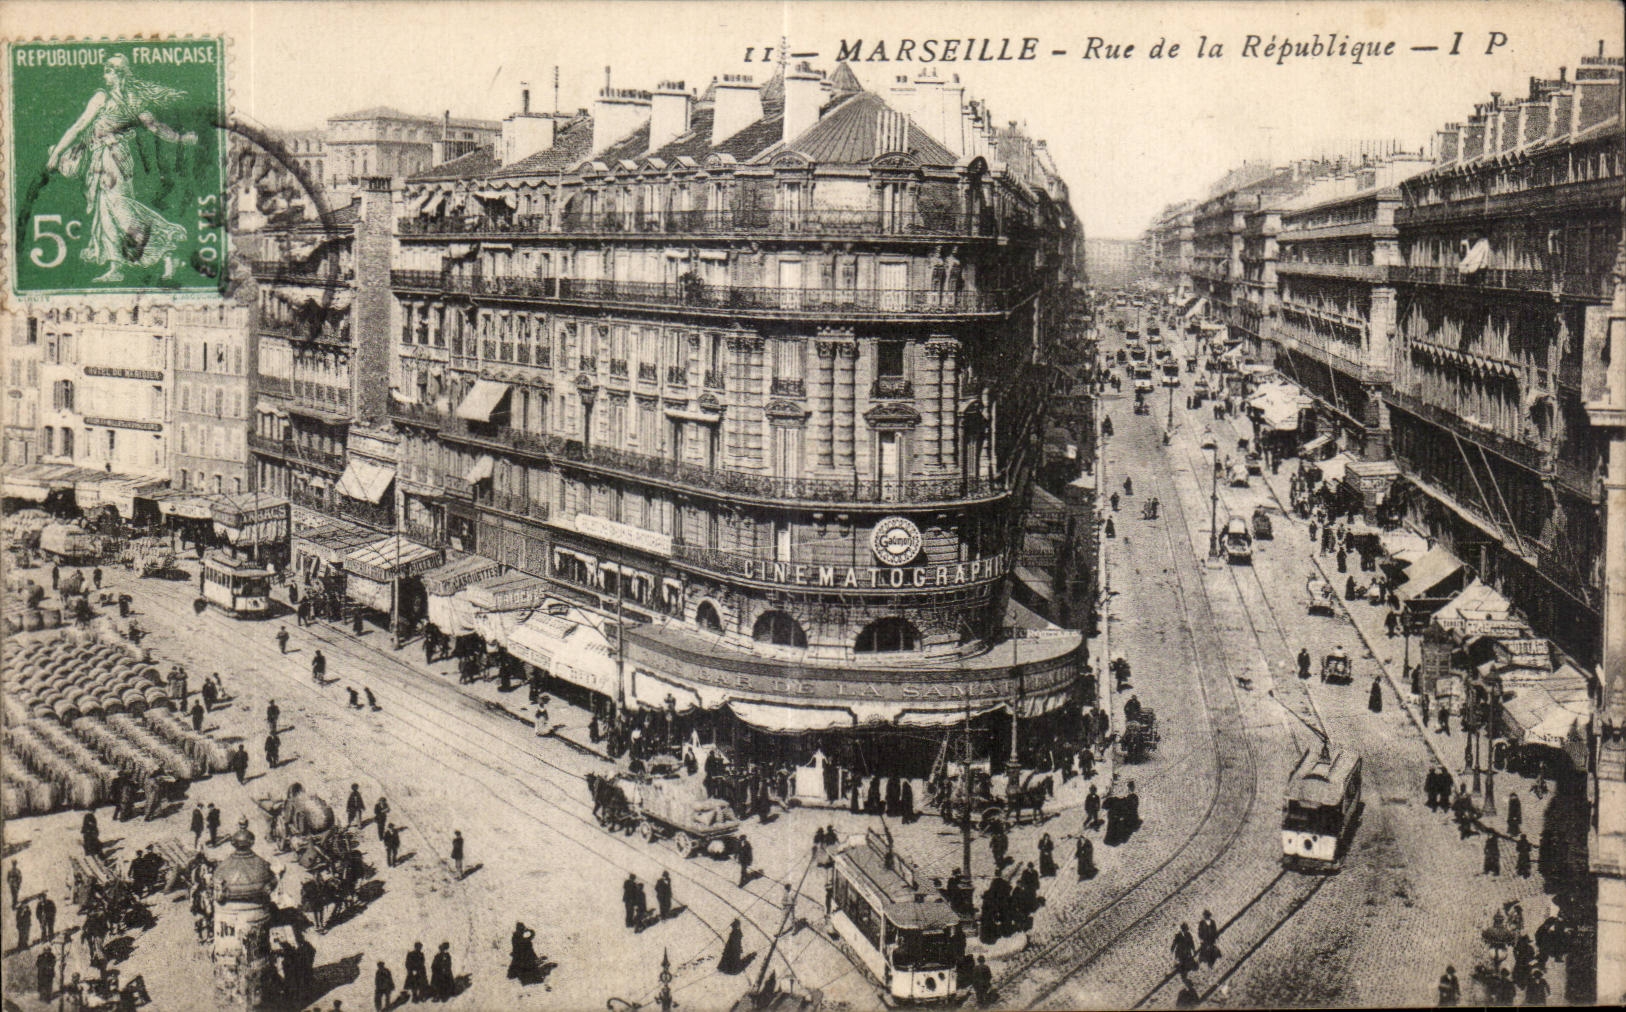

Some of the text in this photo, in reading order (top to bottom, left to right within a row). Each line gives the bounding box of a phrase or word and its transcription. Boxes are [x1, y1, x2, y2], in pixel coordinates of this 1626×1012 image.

[132, 46, 215, 67] FRANÇAISE
[880, 535, 915, 548] Gaumont
[452, 566, 500, 590] CASQUETTES
[772, 679, 815, 697] DE
[837, 681, 883, 698] LA
